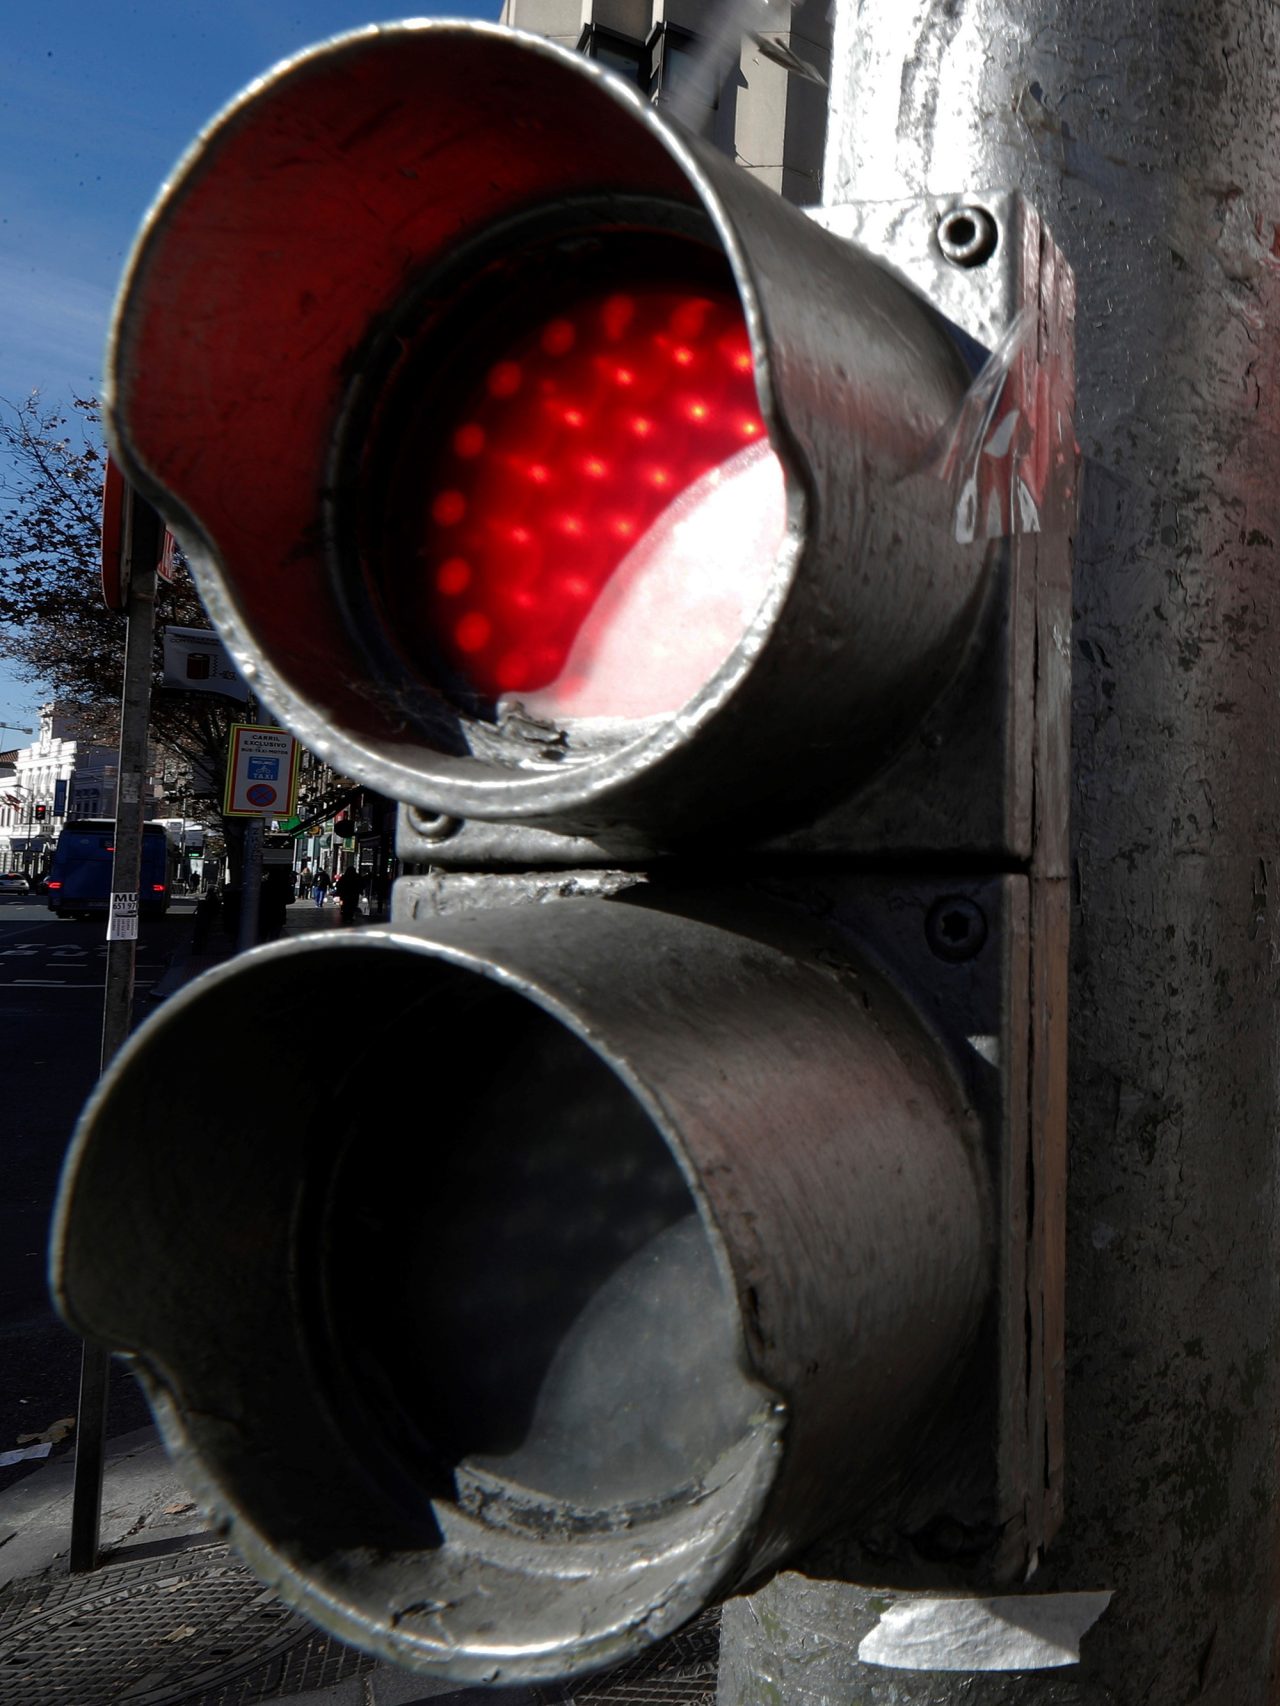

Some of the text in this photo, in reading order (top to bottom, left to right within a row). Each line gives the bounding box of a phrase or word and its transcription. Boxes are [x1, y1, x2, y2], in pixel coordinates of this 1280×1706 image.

[252, 734, 280, 742] CARRIL
[244, 740, 287, 749] EXCLUSIVO
[114, 893, 137, 902] MU
[127, 902, 137, 910] 97
